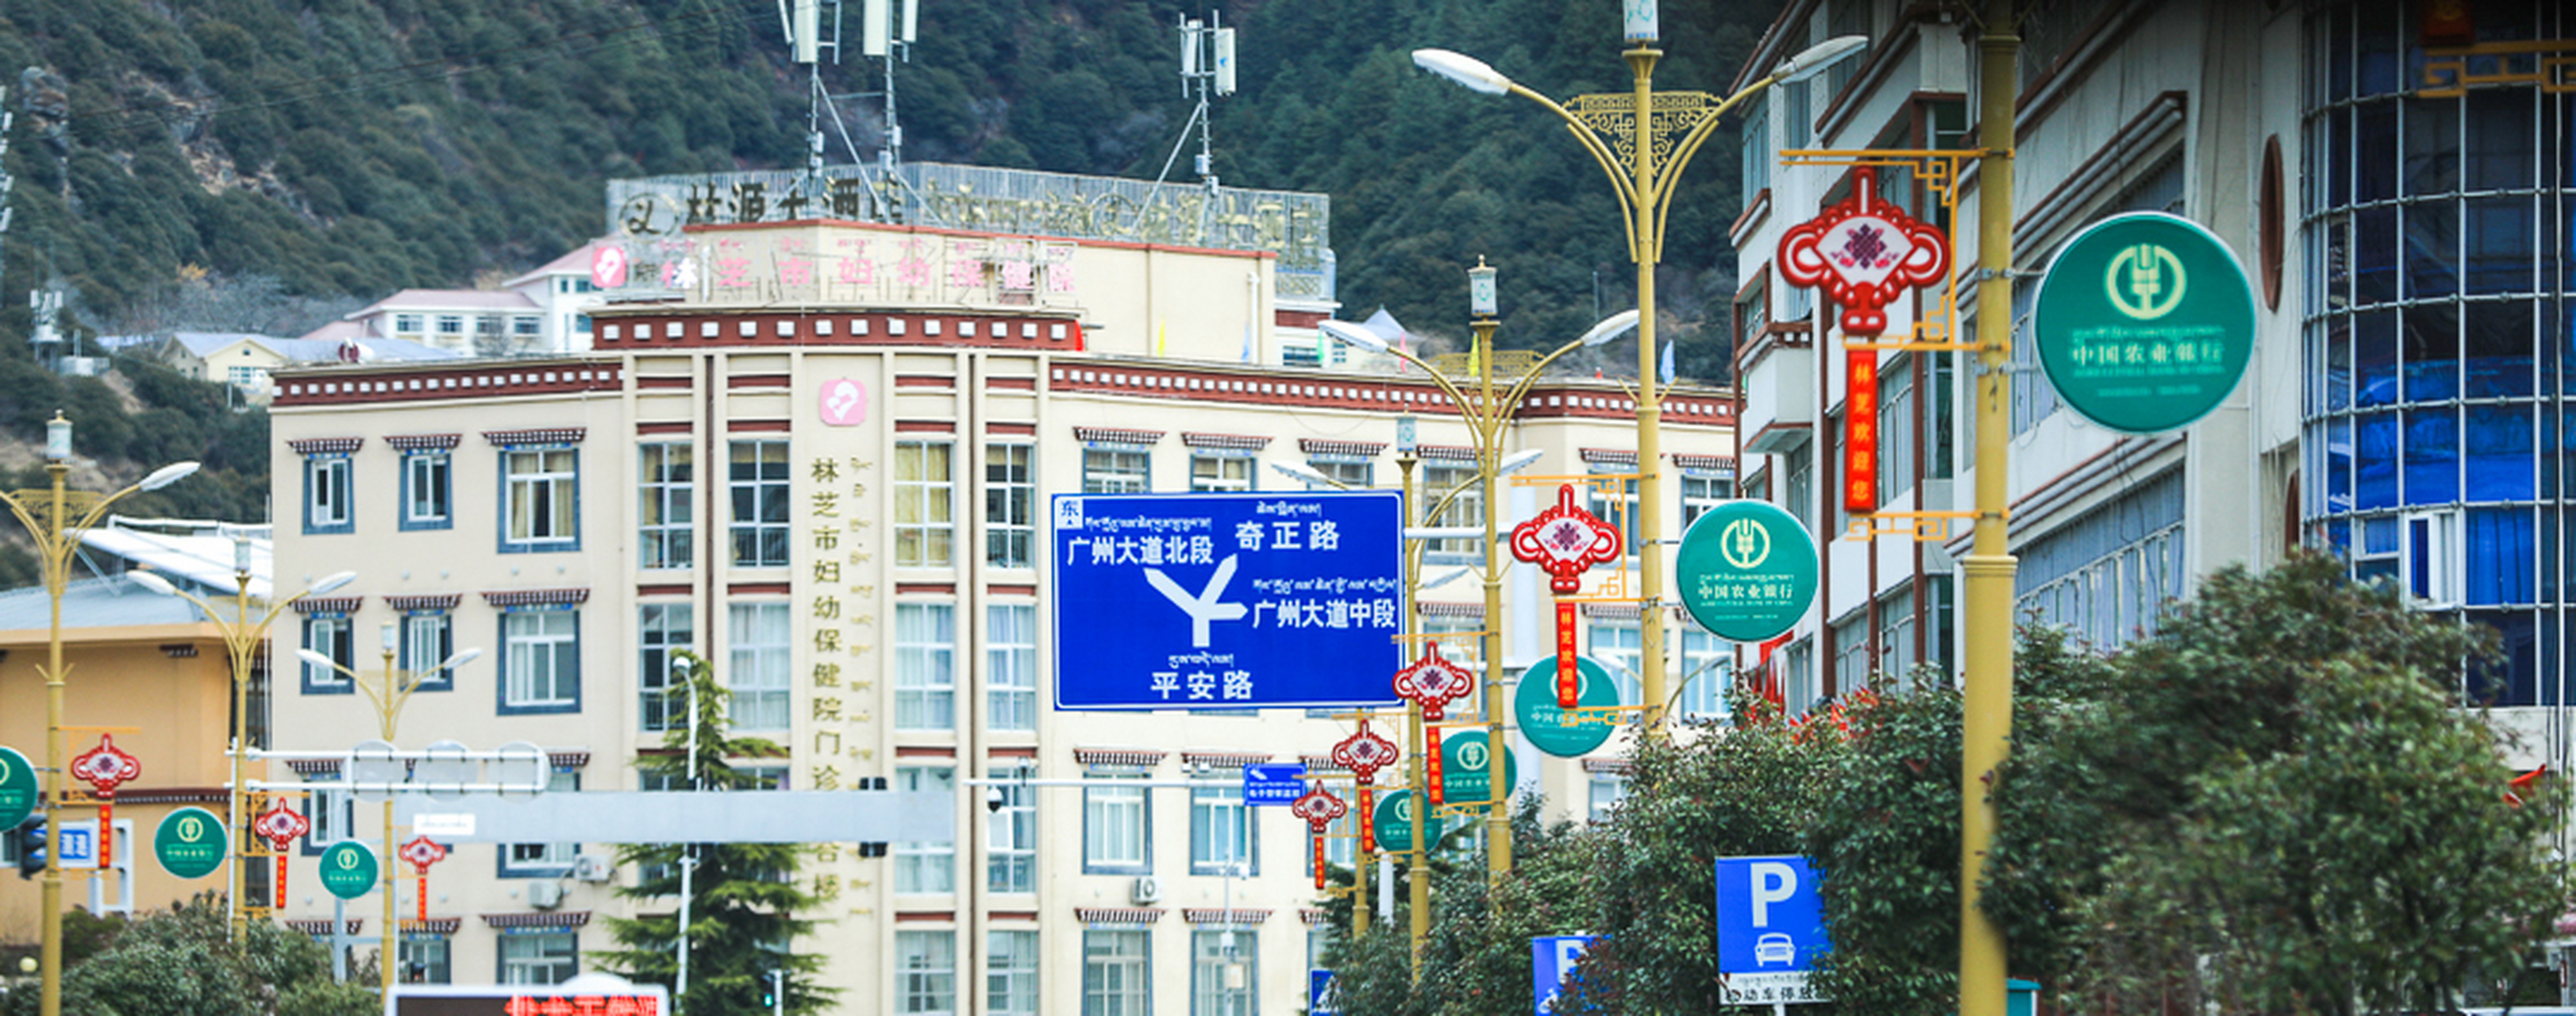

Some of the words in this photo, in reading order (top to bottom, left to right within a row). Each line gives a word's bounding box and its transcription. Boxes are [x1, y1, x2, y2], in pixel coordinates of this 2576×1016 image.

[660, 256, 1075, 291] 林芝市妇幼保健院
[2071, 343, 2225, 366] 中国农业银行
[1852, 364, 1872, 501] 林芝欢迎您
[1068, 535, 1214, 566] 广州大道北段
[1235, 520, 1340, 552] 奇正路
[1698, 583, 1793, 599] 中国农业银行
[1253, 598, 1396, 629] 广州大道中段
[811, 457, 842, 900] 林芝市妇幼保健院门诊合楼
[1150, 671, 1253, 700] 平安路
[1750, 862, 1797, 927] P
